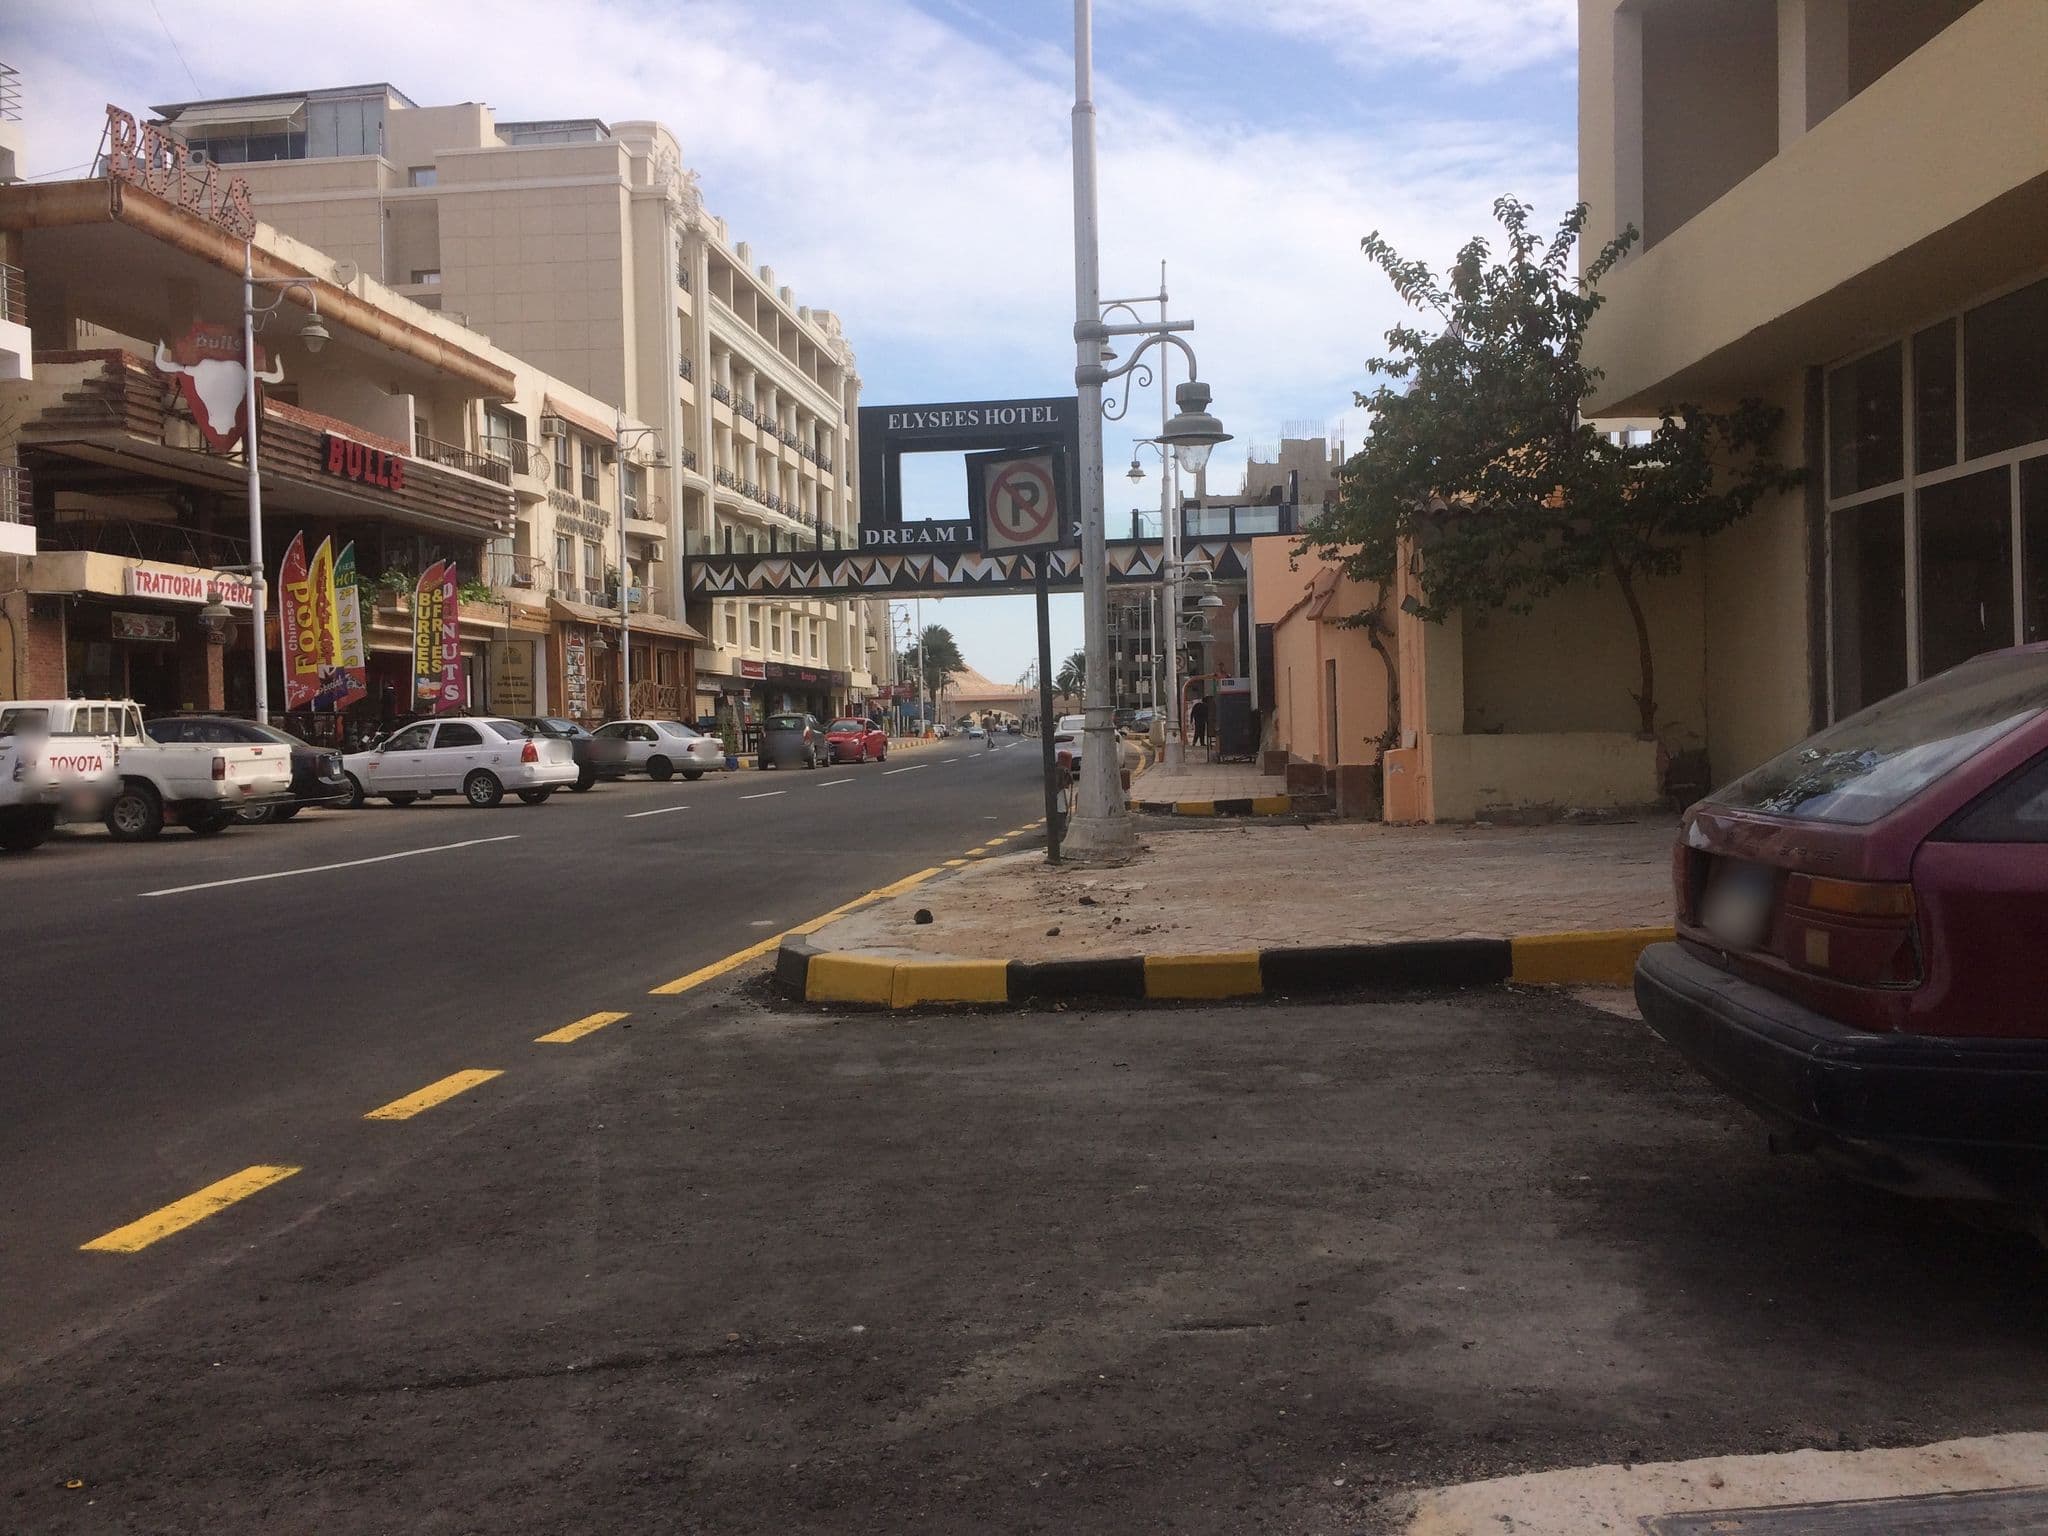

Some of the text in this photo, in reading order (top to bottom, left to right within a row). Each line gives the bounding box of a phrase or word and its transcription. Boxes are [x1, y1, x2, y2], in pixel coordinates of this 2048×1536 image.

[105, 103, 258, 244] BULLS
[887, 406, 1059, 430] ELYSEES HOTEL
[328, 436, 405, 491] BULLS
[864, 526, 957, 545] DREAM
[135, 570, 203, 599] TRATTORIA
[336, 575, 356, 587] HOT
[432, 588, 443, 602] &
[286, 600, 299, 651] Chinese
[286, 581, 318, 675] Food
[338, 588, 359, 667] PIZZA
[417, 592, 431, 675] BURGER
[431, 604, 443, 674] FRIES
[49, 755, 103, 772] TOYOTA
